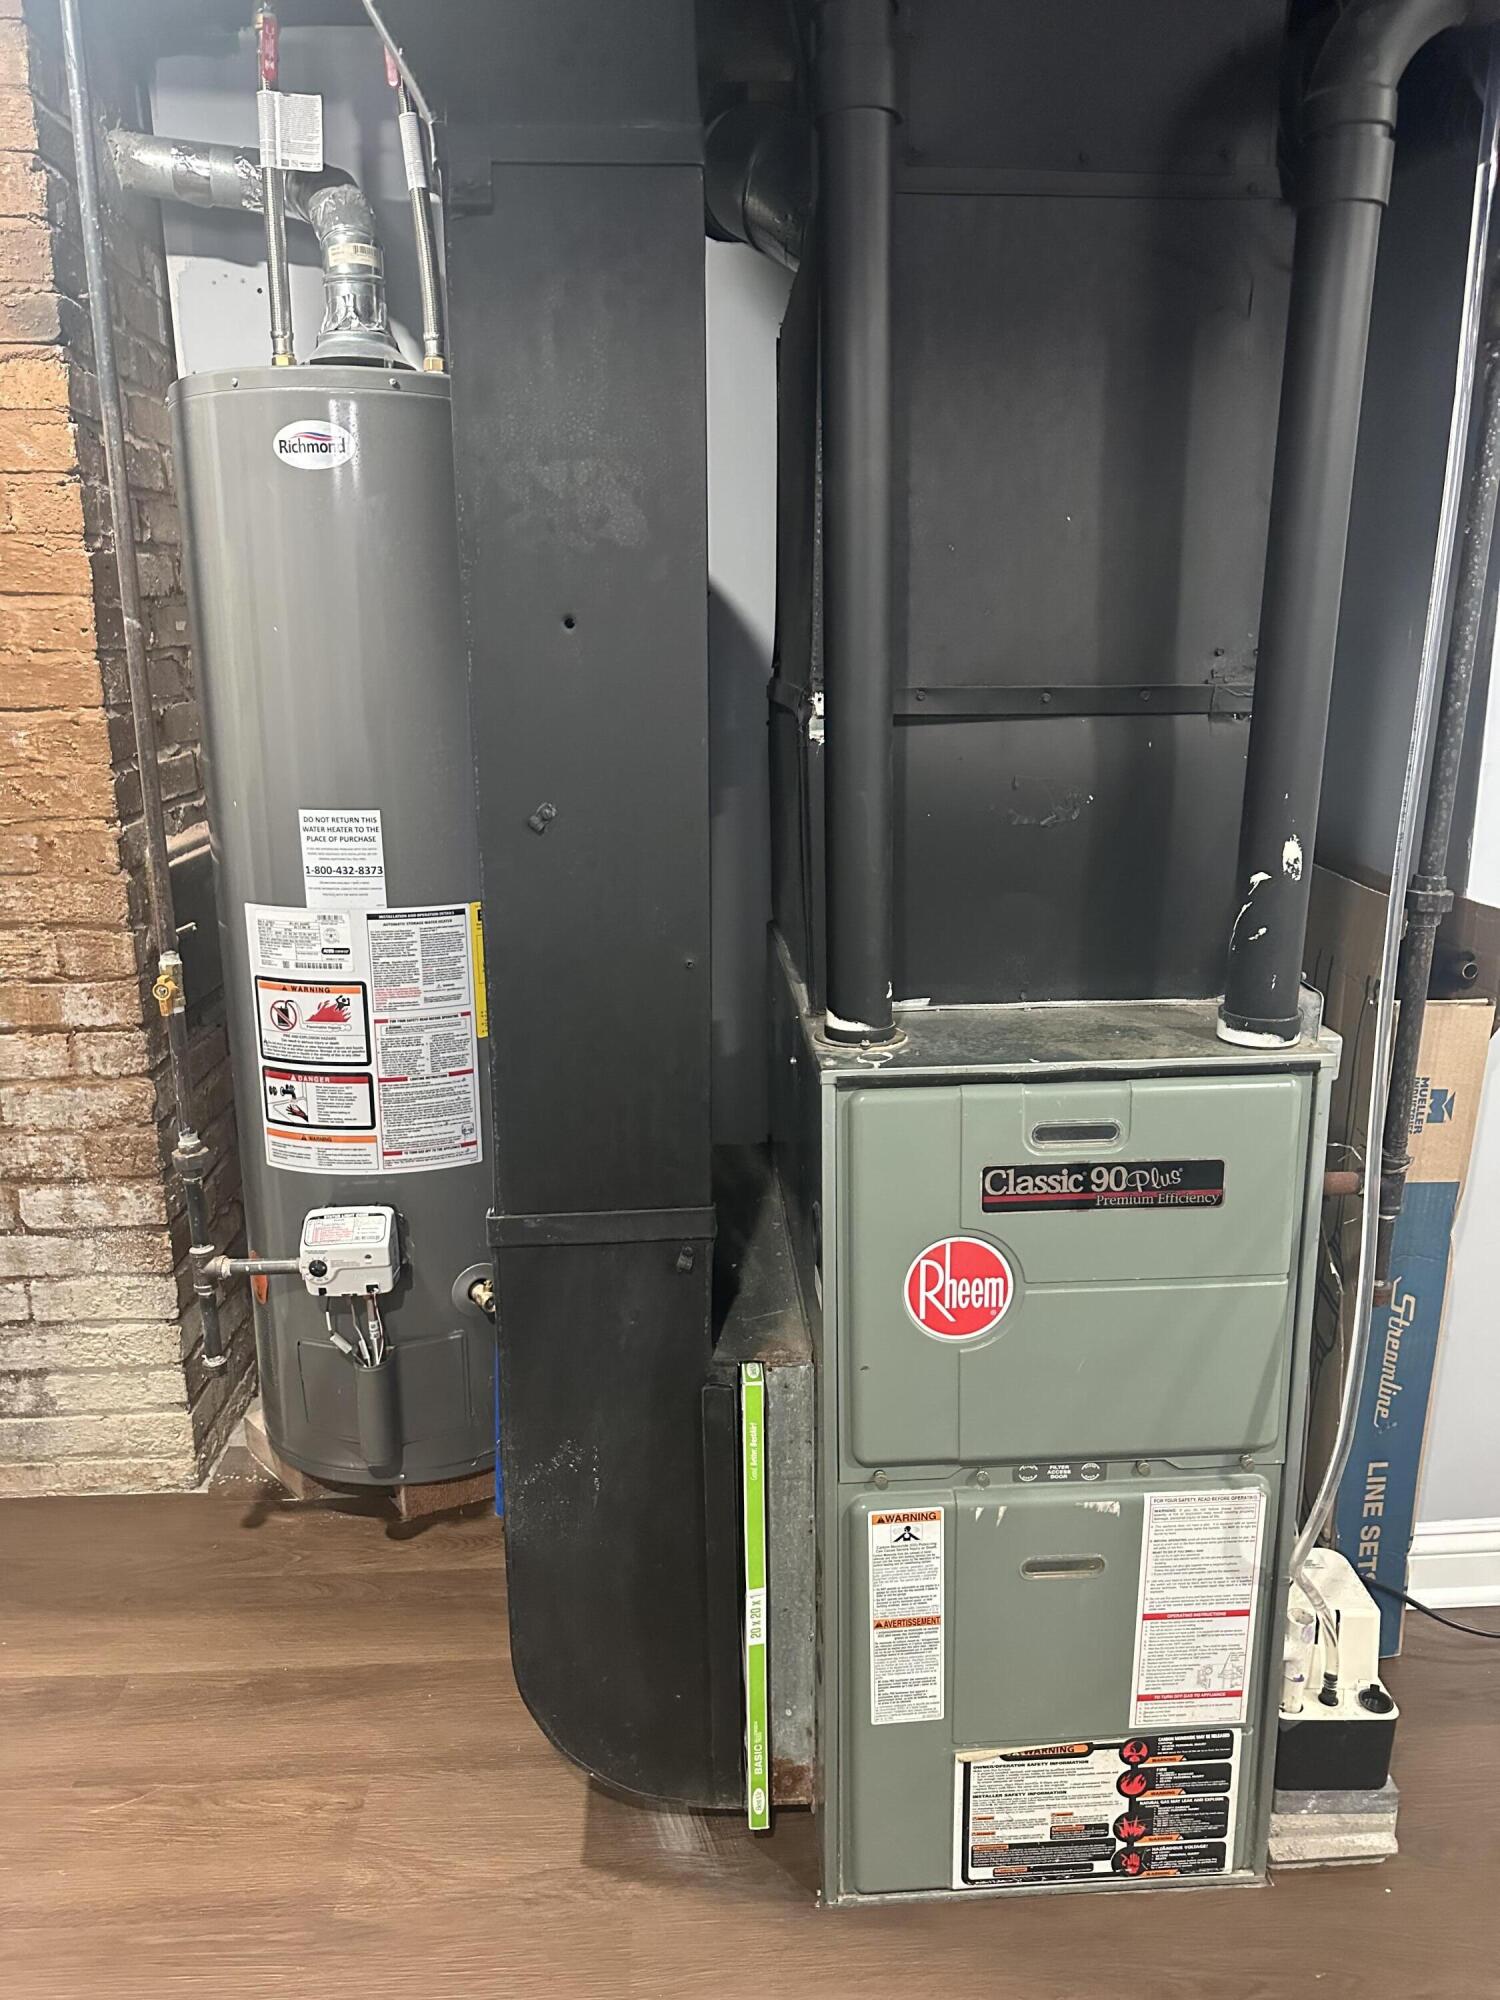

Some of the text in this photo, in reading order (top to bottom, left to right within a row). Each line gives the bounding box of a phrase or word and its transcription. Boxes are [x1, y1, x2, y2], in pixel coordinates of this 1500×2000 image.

[279, 437, 346, 453] Richmond
[305, 866, 384, 875] 1-800-432-8373
[290, 985, 331, 994] WARNING
[1414, 1077, 1430, 1134] MUELLER
[984, 1168, 1084, 1196] Classic
[1096, 1192, 1220, 1206] Premium Efficiency
[919, 1242, 1004, 1322] Rheem
[1374, 1276, 1416, 1428] Streamline
[1362, 1461, 1389, 1518] LINE
[885, 1512, 936, 1523] WARNING
[751, 1606, 760, 1617] 20
[884, 1616, 940, 1628] AVERTISSEMENT
[751, 1624, 760, 1638] 20
[1022, 1745, 1074, 1755] WARNING
[754, 1744, 762, 1775] BASIC
